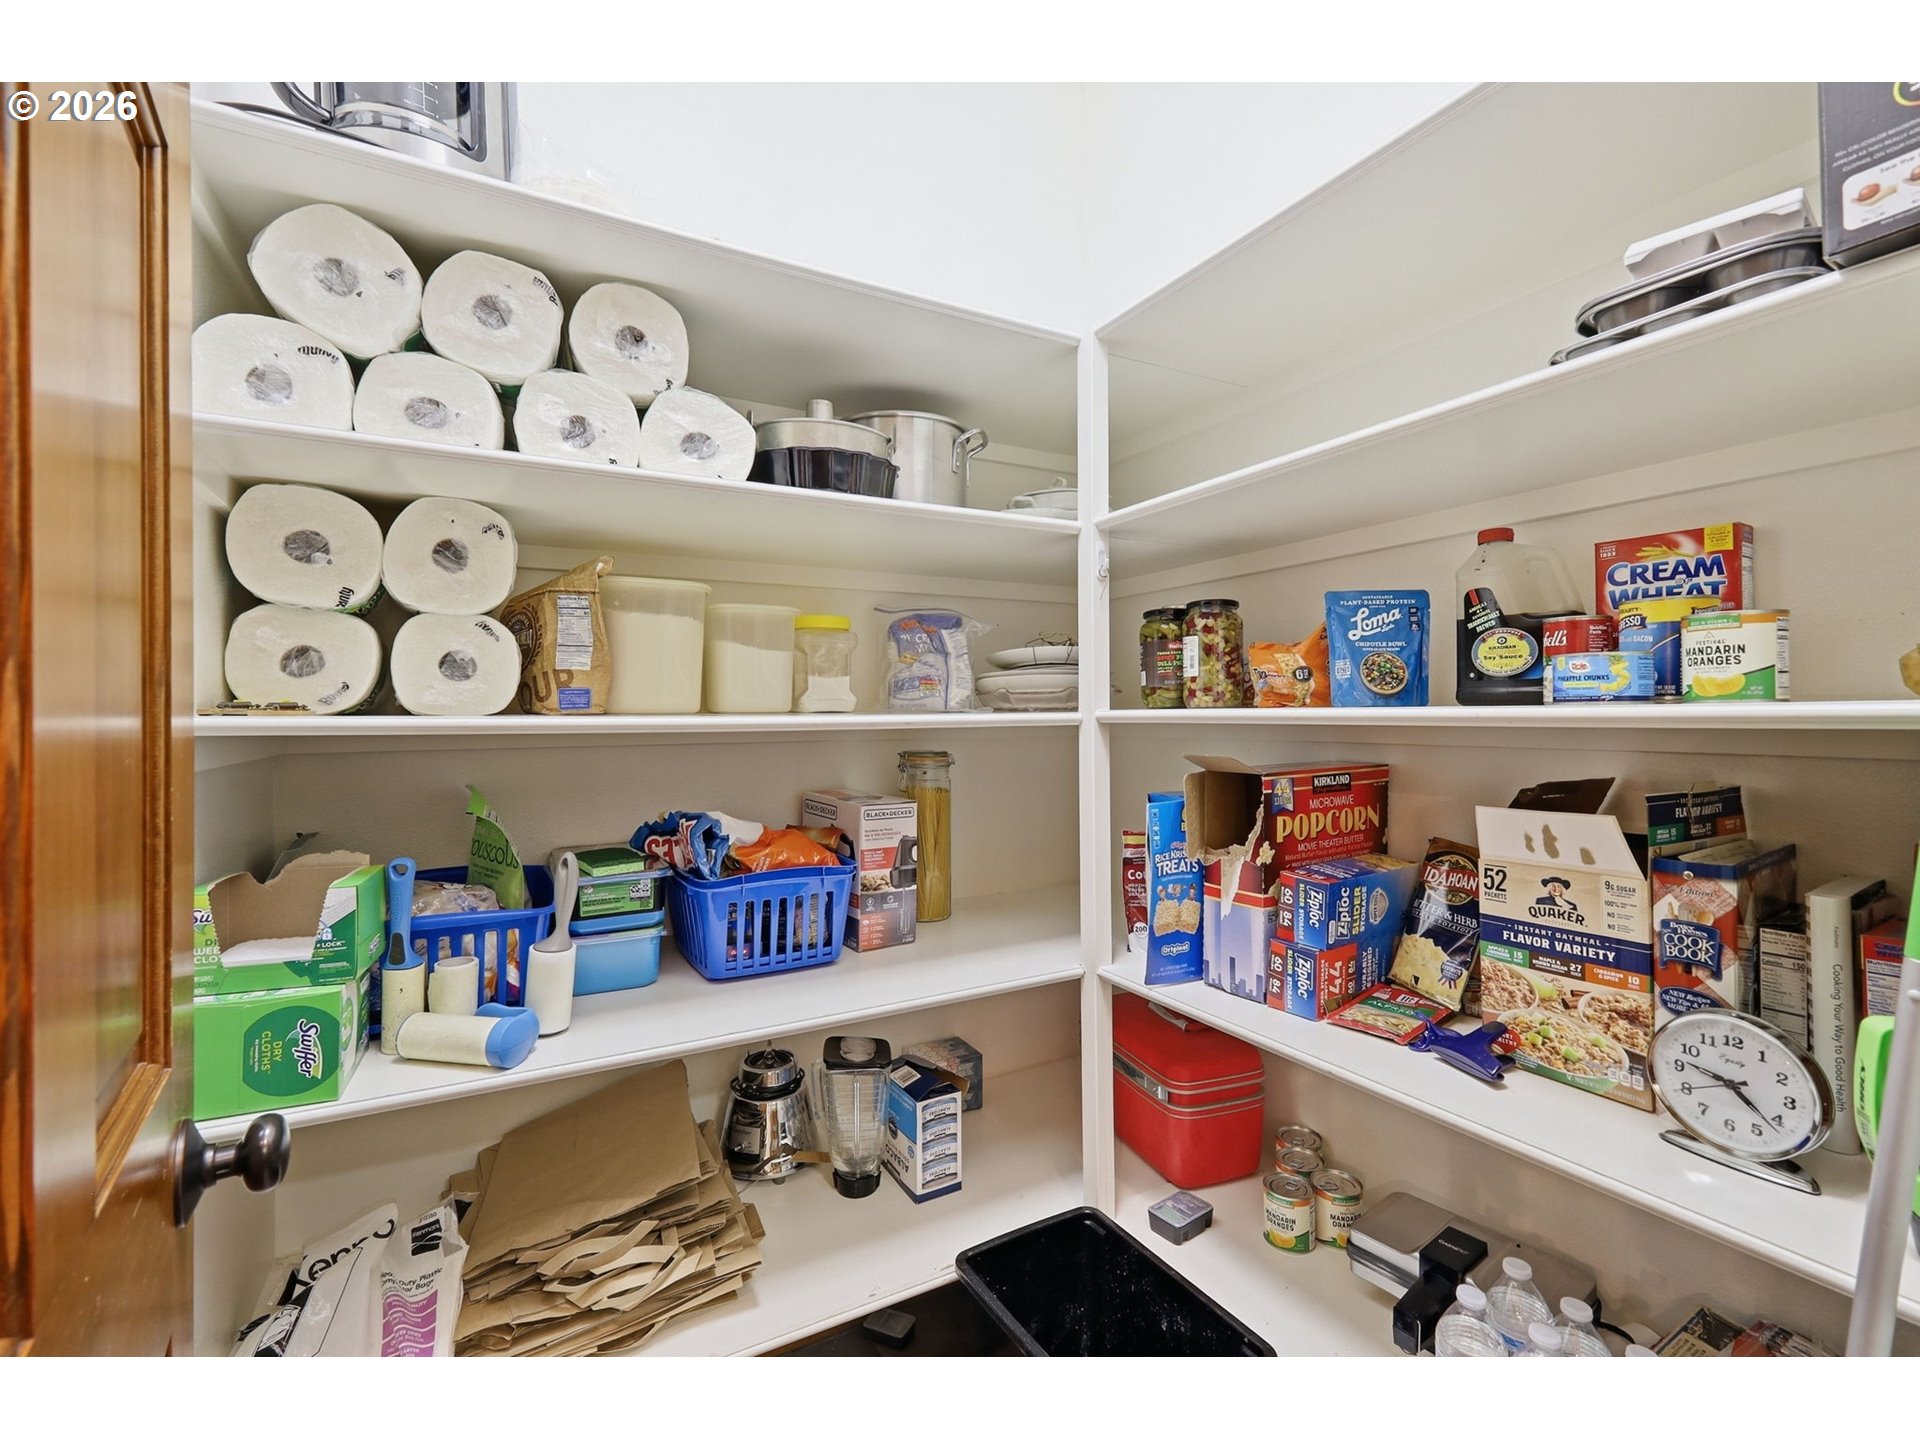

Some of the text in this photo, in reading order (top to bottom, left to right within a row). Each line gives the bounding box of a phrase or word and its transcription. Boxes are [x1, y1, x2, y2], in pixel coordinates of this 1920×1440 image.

[1606, 553, 1727, 587] CREAM
[1348, 607, 1402, 641] Loma
[1633, 635, 1653, 643] BACON
[1685, 644, 1746, 657] MANDARIN
[1688, 655, 1742, 667] ORANGES
[1314, 775, 1350, 787] KIRKLAND
[1309, 794, 1355, 809] MICROWAVE
[1276, 803, 1380, 843] POPCORN
[1297, 833, 1364, 852] MOVIE THEATER BUTTER
[1155, 854, 1170, 864] RICE
[1156, 859, 1199, 877] TREATS
[1424, 865, 1478, 892] IDAHOAN
[1483, 868, 1507, 893] 52
[1284, 888, 1293, 904] 60
[1484, 891, 1507, 901] PACKETS
[1616, 885, 1636, 893] SUGAR
[1309, 889, 1323, 928] Ziploc
[1337, 887, 1350, 936] Ziploc
[1352, 886, 1362, 935] SLIDER
[1604, 900, 1620, 908] 100%
[1282, 912, 1292, 927] 84
[1444, 911, 1478, 928] & HERB
[1528, 906, 1585, 927] QUAKER
[1607, 911, 1616, 919] NO
[1607, 923, 1616, 931] NO
[1514, 924, 1601, 946] INSTANT OATMEAL
[1161, 941, 1190, 956] Original
[1502, 930, 1616, 963] FLAVOR VARIETY
[1663, 933, 1716, 954] COOK
[1513, 951, 1523, 959] 15
[1665, 944, 1714, 966] BOOK
[1274, 956, 1283, 973] 60
[1569, 963, 1582, 972] 27
[1867, 960, 1902, 969] Nutrition
[1297, 957, 1311, 999] Ziploc
[1627, 976, 1640, 985] 10
[1272, 978, 1281, 994] 84
[1662, 993, 1679, 1003] NEW
[1679, 998, 1691, 1007] Tips
[1668, 989, 1711, 1004] NEW Recipes
[1700, 1033, 1717, 1048] 11
[1722, 1035, 1744, 1050] 12
[1831, 964, 1847, 1113] Cooking Your Way to Good Health
[273, 1041, 282, 1061] DRY
[292, 1018, 320, 1079] Swiffer
[1680, 1043, 1700, 1058] 10
[1757, 1050, 1768, 1063] 1
[1674, 1059, 1685, 1072] 9
[1776, 1072, 1788, 1086] 2
[1680, 1082, 1693, 1096] 8
[1698, 1102, 1709, 1116] 7
[1783, 1096, 1797, 1111] 3
[1724, 1119, 1736, 1132] 6
[1771, 1114, 1785, 1128] 4
[1751, 1123, 1763, 1137] 5
[1265, 1207, 1296, 1225] MANDARIN
[1266, 1214, 1294, 1231] ORANGES
[415, 1267, 443, 1284] Plastic
